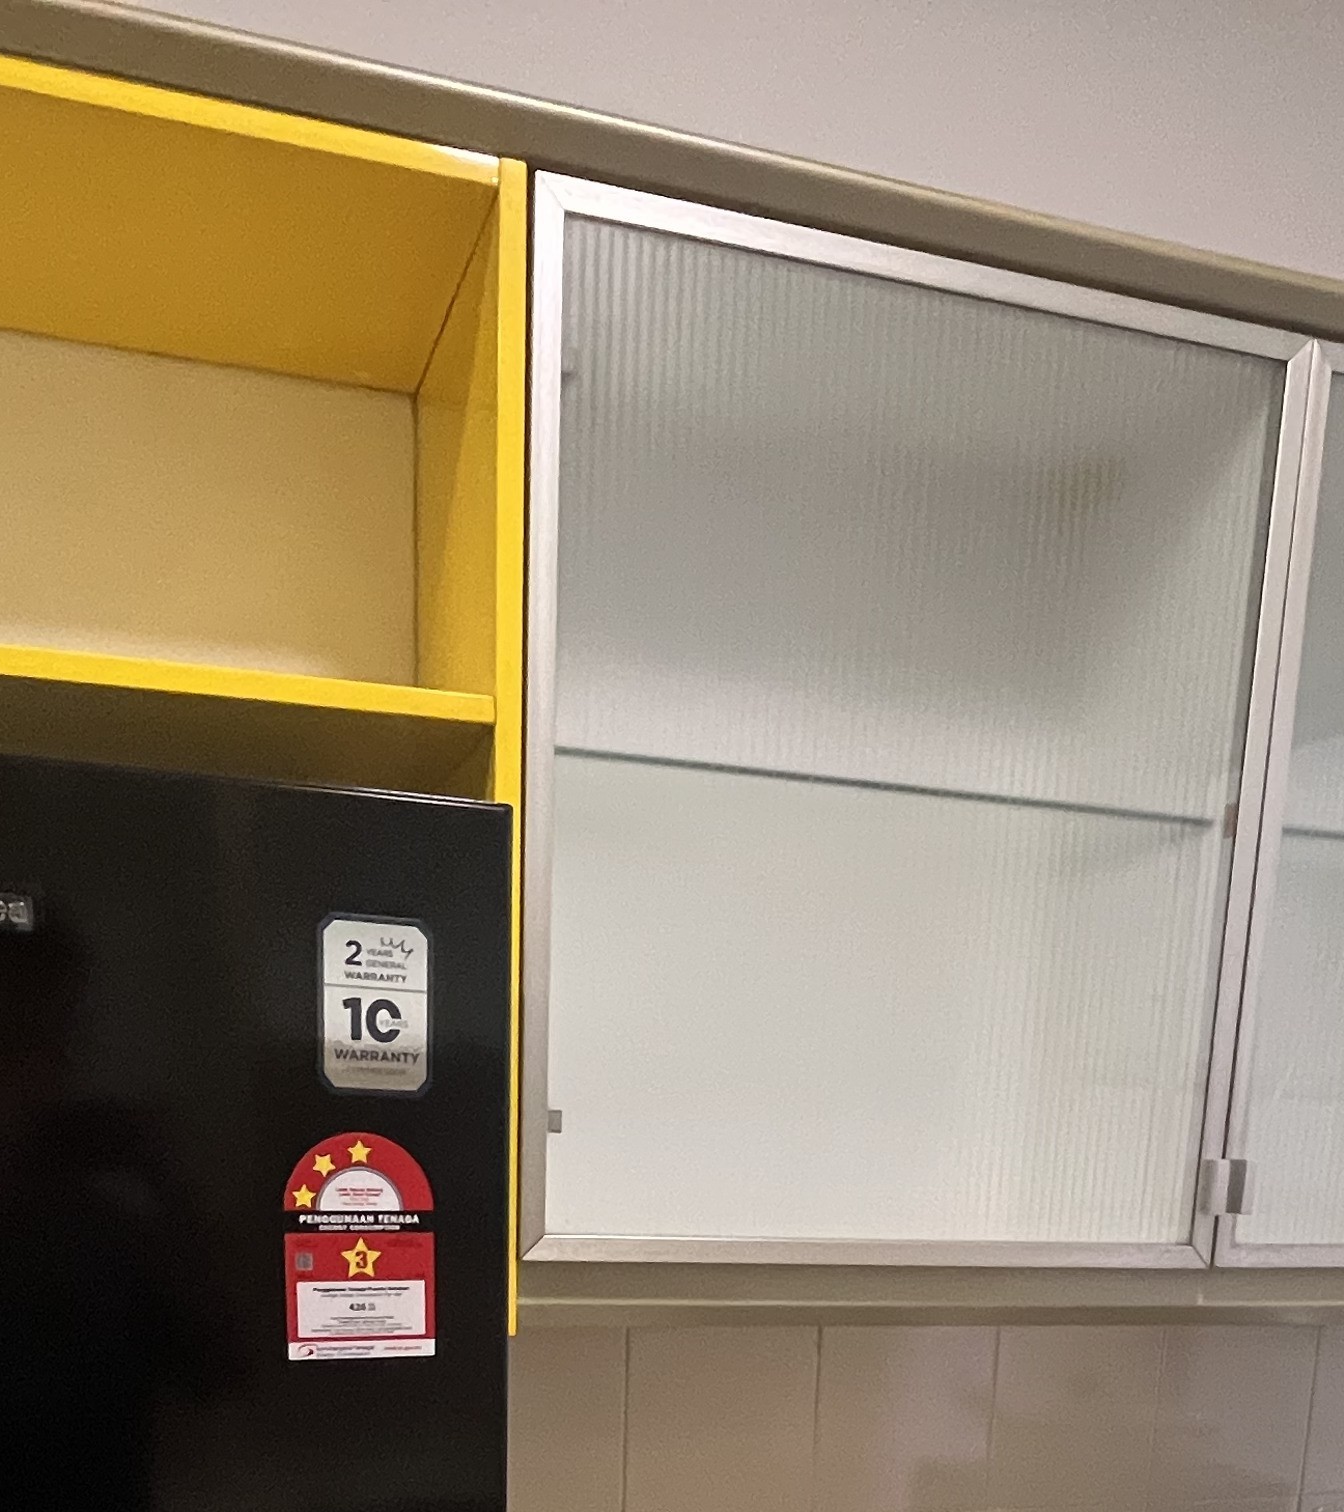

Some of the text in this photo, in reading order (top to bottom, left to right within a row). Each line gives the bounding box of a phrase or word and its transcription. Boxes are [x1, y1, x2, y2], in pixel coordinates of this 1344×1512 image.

[344, 940, 362, 966] 2
[344, 971, 406, 983] WARRANTY
[334, 1048, 420, 1065] WARRANTY
[356, 1251, 367, 1268] 3
